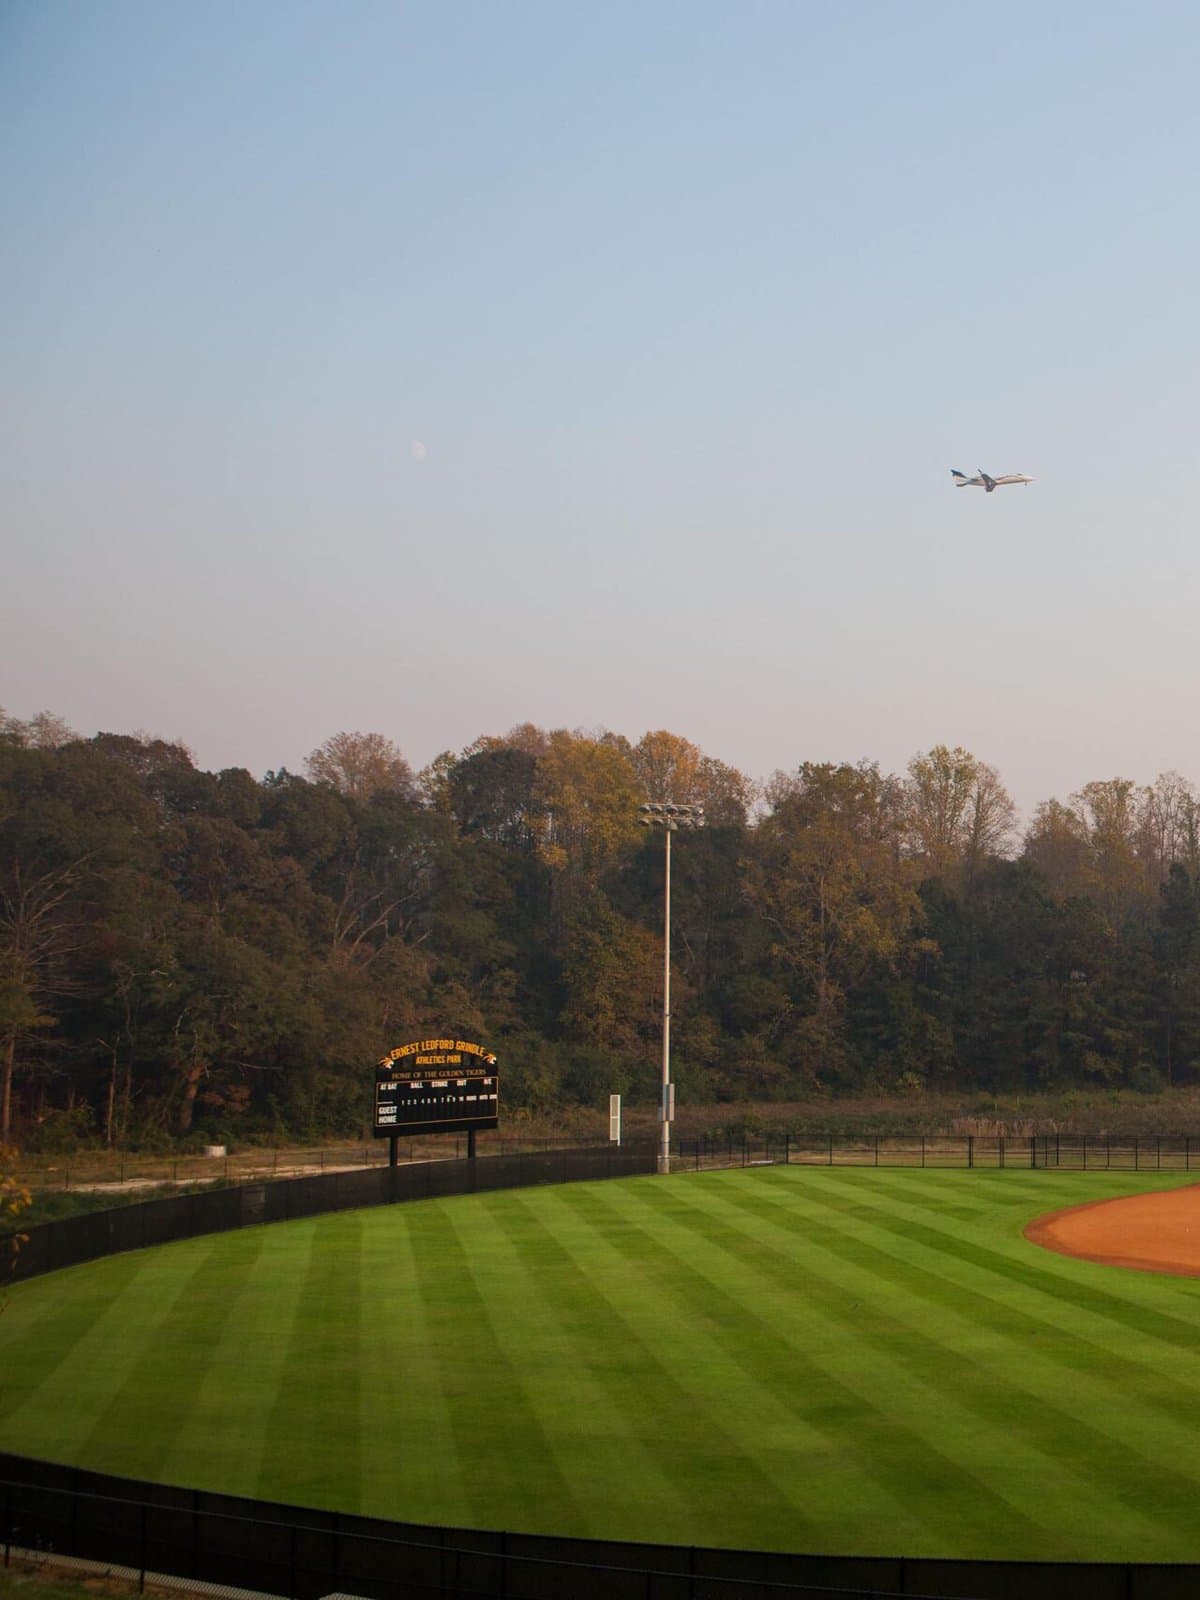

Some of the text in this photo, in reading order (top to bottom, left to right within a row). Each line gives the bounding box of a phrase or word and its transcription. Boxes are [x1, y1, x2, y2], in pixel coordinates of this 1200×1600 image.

[390, 1039, 486, 1060] ERNEST LEDFORD GRINDLE
[416, 1055, 461, 1065] ATHLETICS PARK
[439, 1069, 464, 1077] GOLDEN
[467, 1068, 486, 1076] TIGERS
[410, 1081, 423, 1089] BALL
[378, 1106, 397, 1114] GUEST
[378, 1115, 397, 1124] HOME
